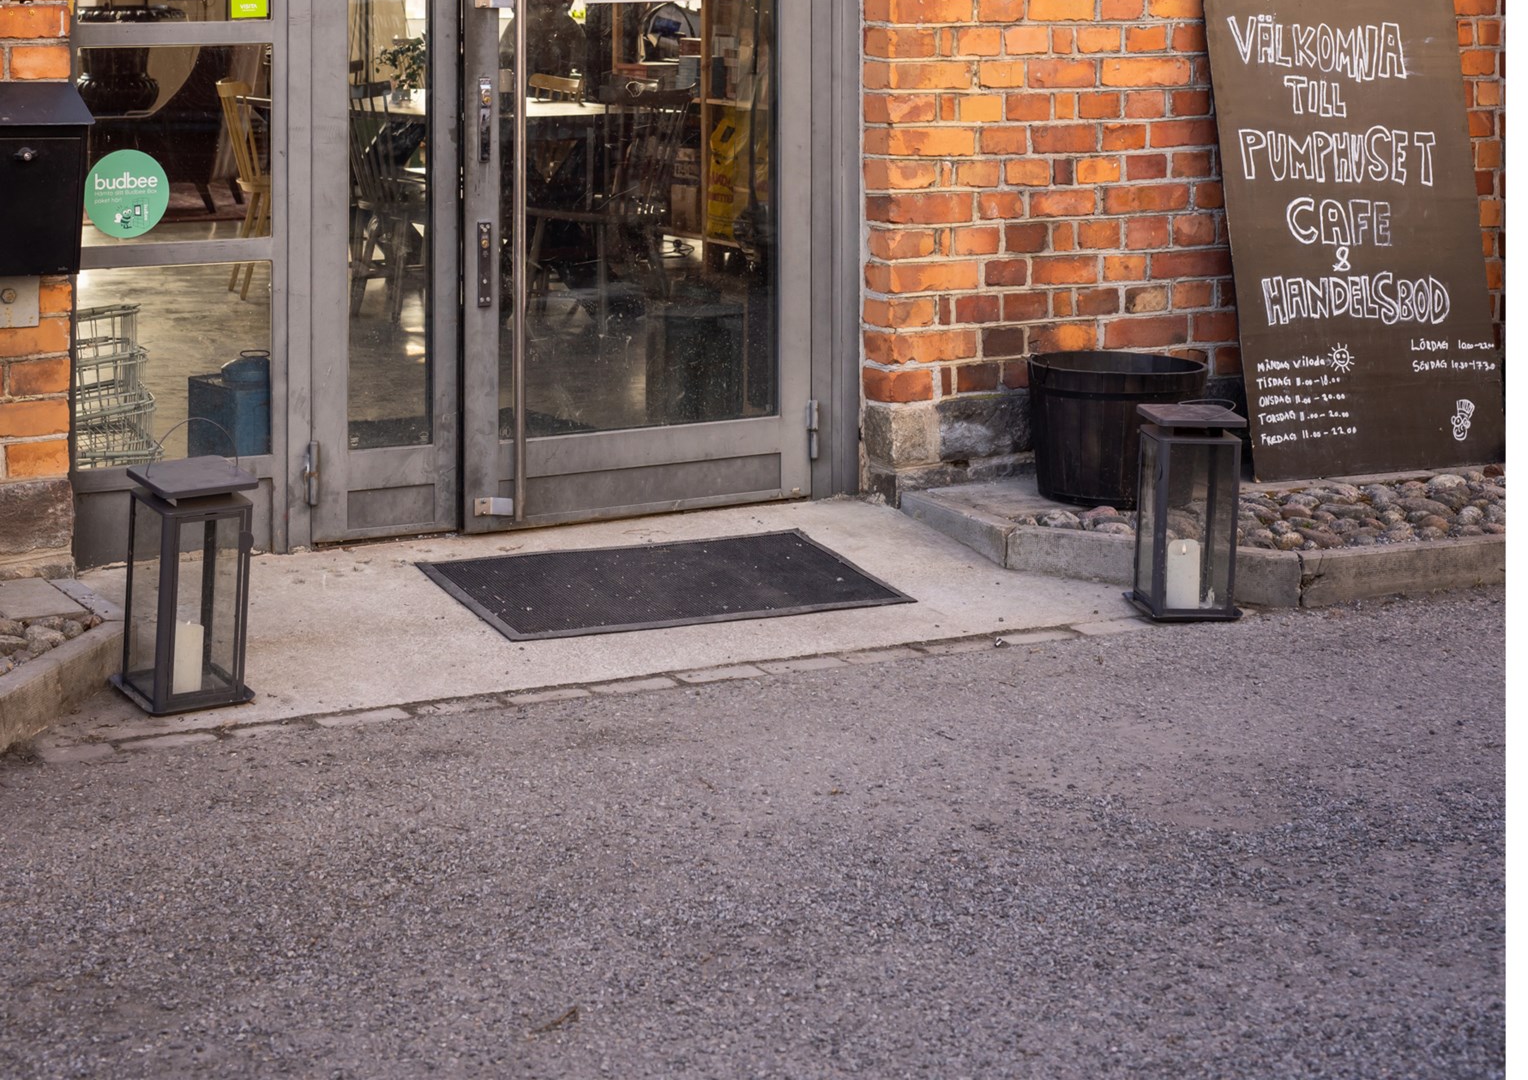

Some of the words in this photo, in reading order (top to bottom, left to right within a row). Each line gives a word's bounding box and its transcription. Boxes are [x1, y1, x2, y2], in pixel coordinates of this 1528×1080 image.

[1227, 15, 1407, 82] VÄLKOMNA
[1283, 76, 1346, 118] TILL
[1238, 125, 1436, 187] PUMPHUSET
[94, 171, 158, 190] budbee
[1286, 197, 1392, 247] CAFE
[1332, 246, 1352, 272] &
[1261, 271, 1451, 326] HANDELSBOD
[1256, 376, 1291, 390] TISDAG
[1259, 395, 1291, 407] ONSDAG
[1258, 410, 1296, 425] TORSDAG
[1261, 432, 1297, 446] FREDAG
